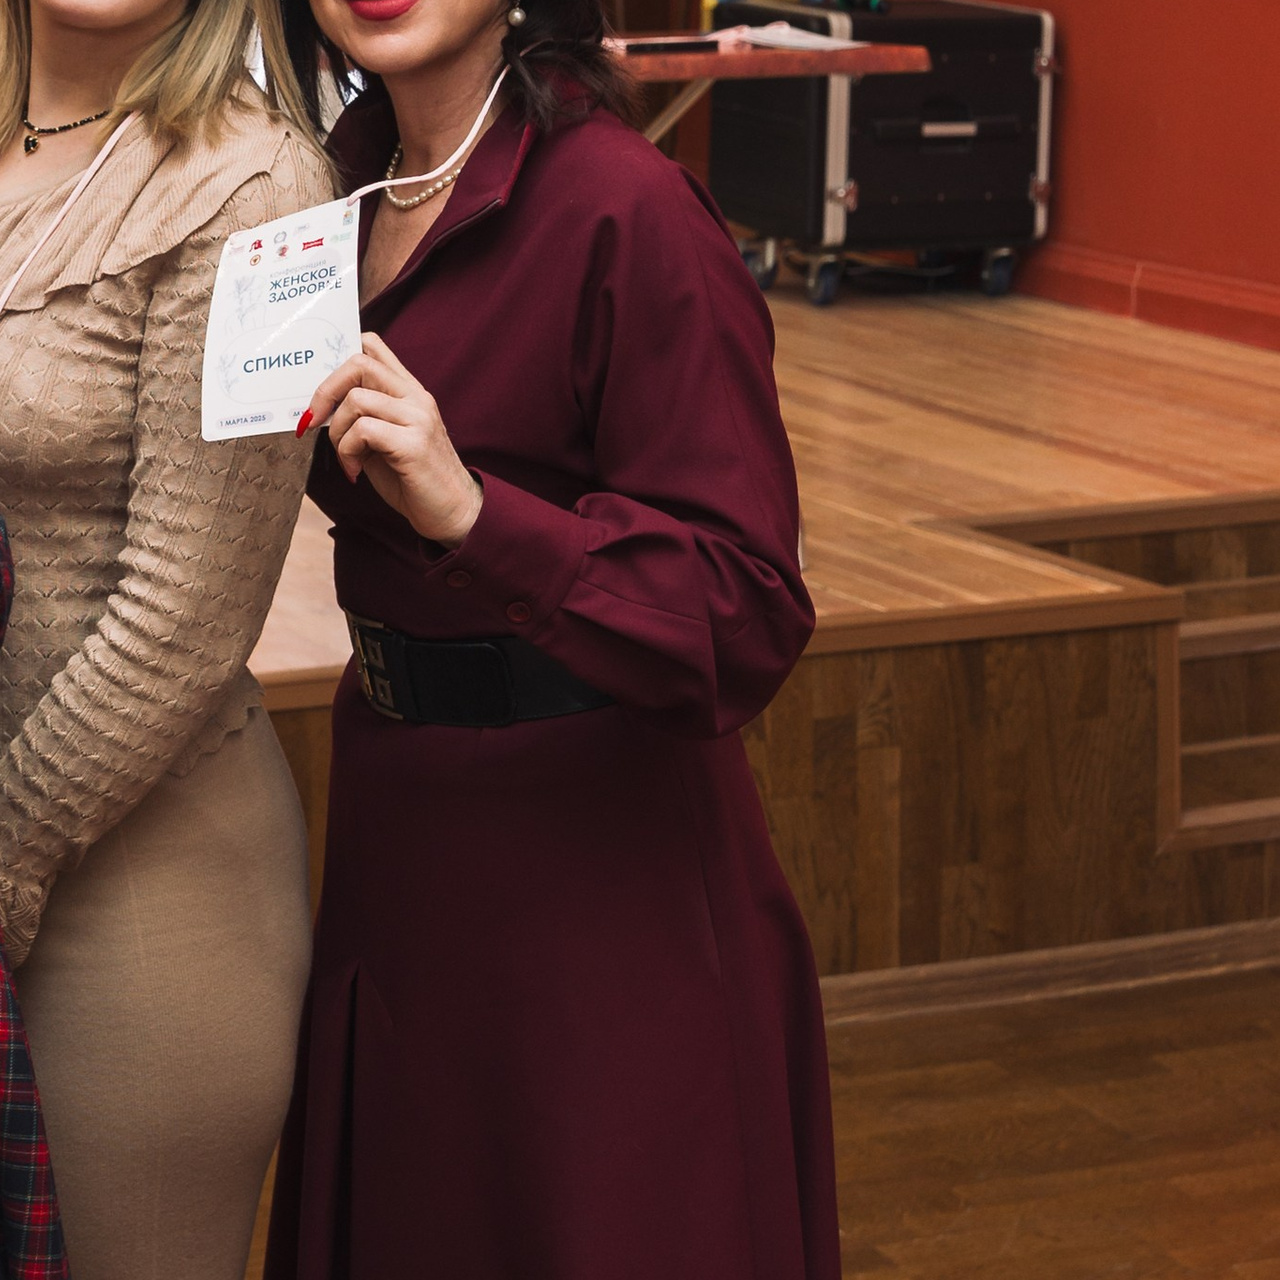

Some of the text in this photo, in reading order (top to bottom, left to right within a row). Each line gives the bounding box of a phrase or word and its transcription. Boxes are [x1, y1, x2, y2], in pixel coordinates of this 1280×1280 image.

[269, 265, 337, 291] ЖЕНСКОЕ
[243, 349, 314, 373] СПИКЕР
[225, 416, 249, 427] МАРТА
[250, 414, 267, 423] 2025
